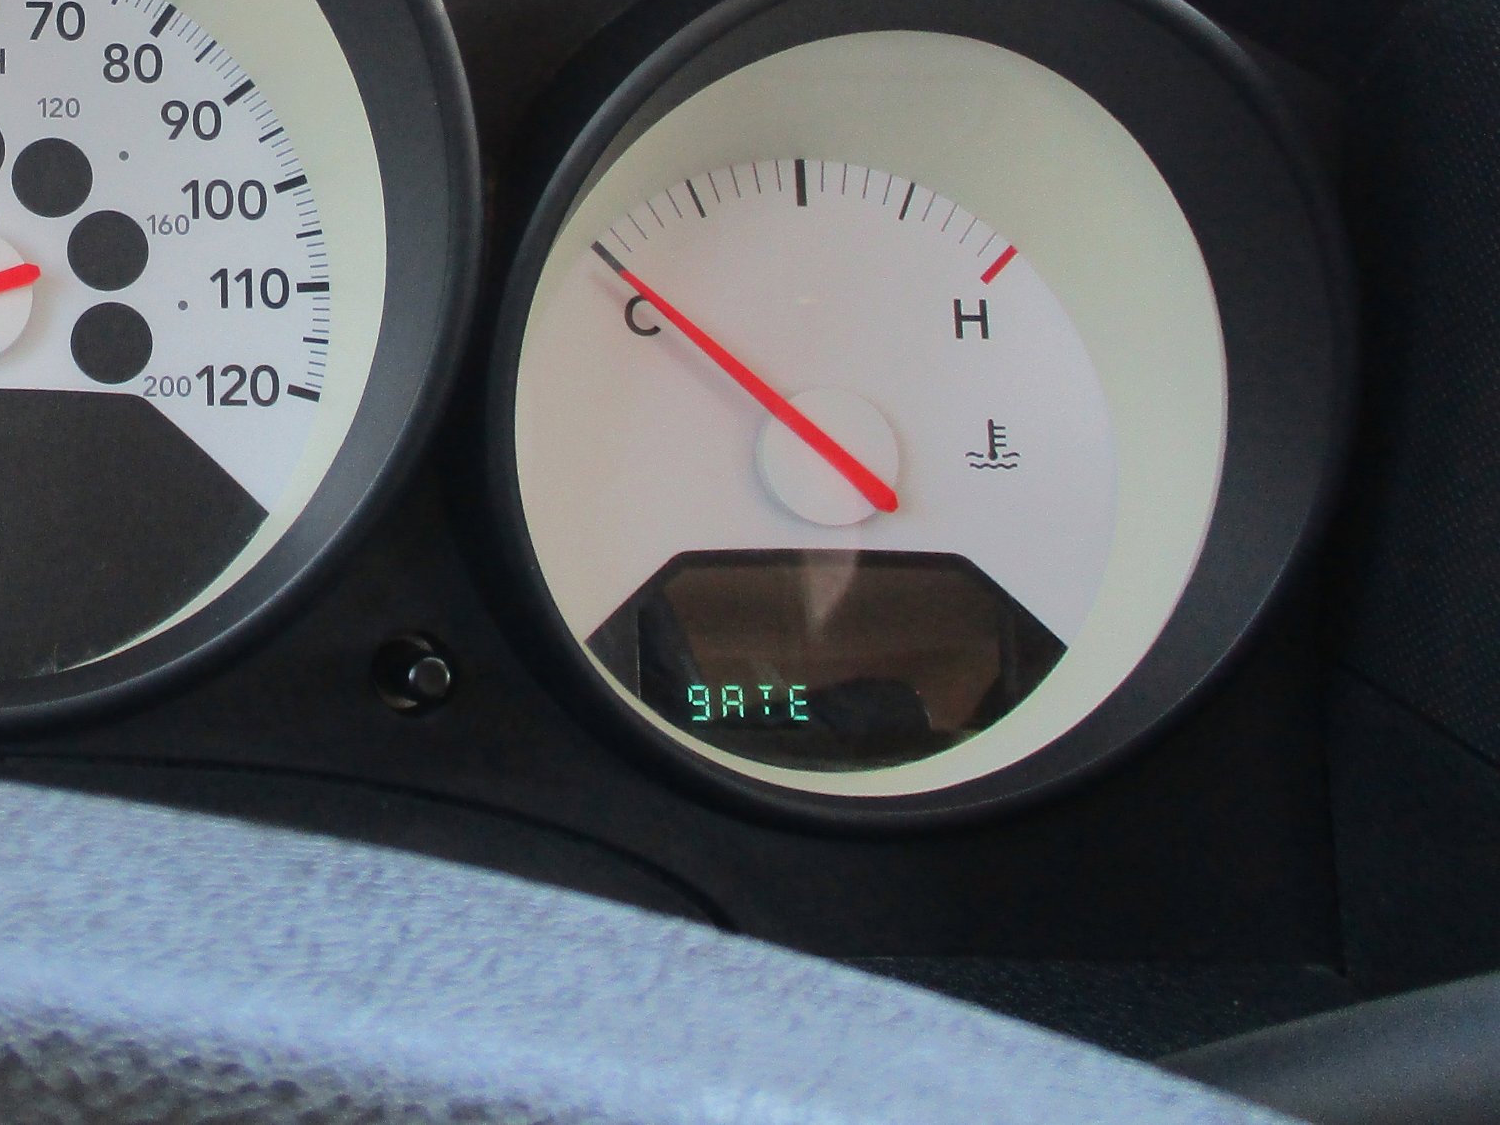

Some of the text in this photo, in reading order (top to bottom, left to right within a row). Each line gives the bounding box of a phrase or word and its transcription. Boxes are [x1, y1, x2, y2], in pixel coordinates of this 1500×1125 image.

[25, 1, 86, 41] 70
[102, 43, 163, 84] 80
[37, 97, 81, 118] 120
[160, 100, 222, 141] 90
[181, 179, 268, 221] 100
[146, 214, 190, 235] 160
[209, 267, 290, 310] 110
[624, 295, 662, 337] C
[953, 298, 990, 340] H
[143, 376, 192, 398] 200
[194, 364, 280, 408] 120
